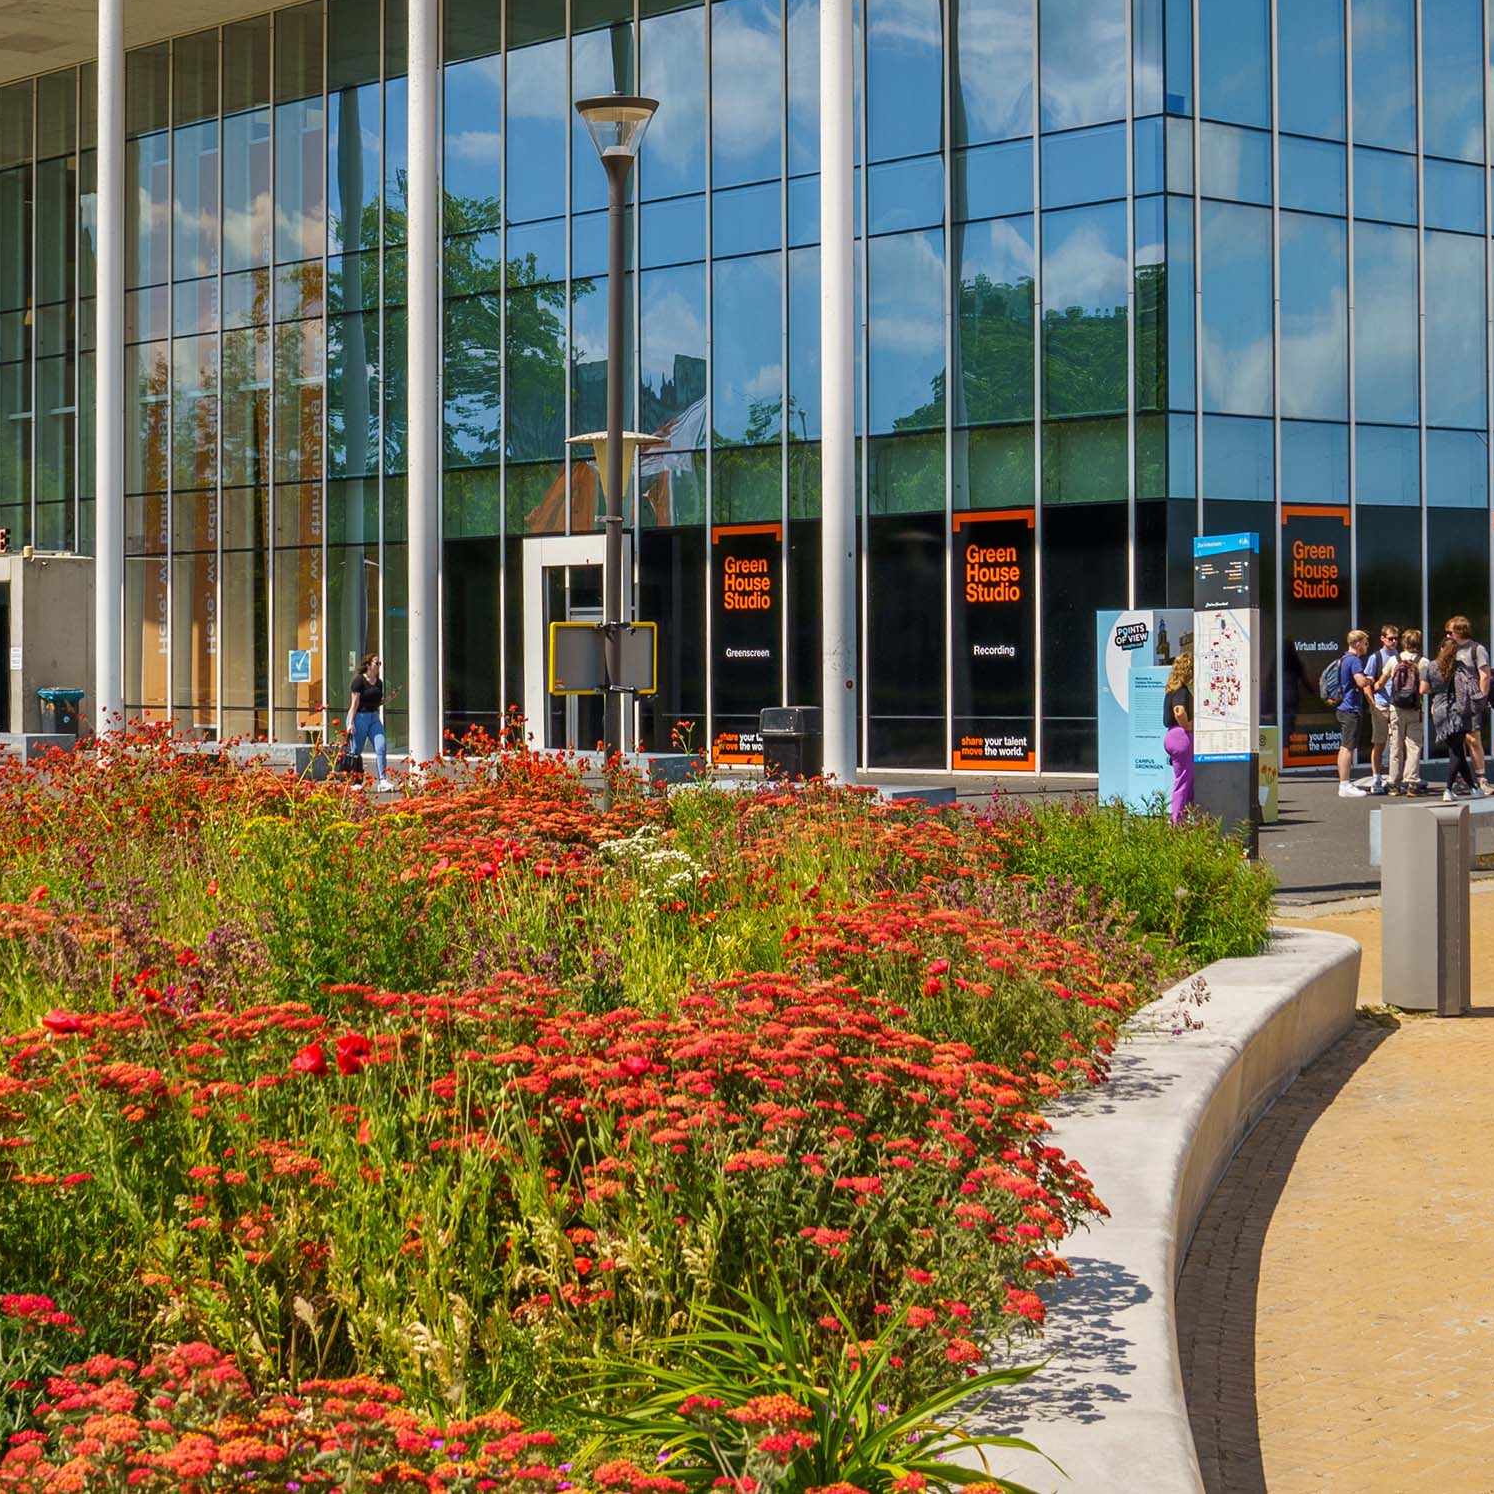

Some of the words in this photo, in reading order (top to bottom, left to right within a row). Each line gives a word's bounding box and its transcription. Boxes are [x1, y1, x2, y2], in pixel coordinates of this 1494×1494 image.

[966, 544, 1017, 563] Green
[1292, 540, 1336, 559] Green
[724, 556, 768, 574] Green
[1293, 560, 1339, 579] House
[966, 564, 1020, 582] House
[724, 574, 771, 591] House
[1292, 579, 1339, 598] Studio
[966, 583, 1020, 602] Studio
[724, 592, 771, 610] Studio
[1117, 624, 1145, 636] POINTS
[1115, 635, 1127, 645] OF
[1127, 632, 1148, 643] VIEW
[973, 645, 1016, 657] Recording
[1294, 641, 1317, 651] Virtual
[1317, 641, 1339, 651] studio
[725, 648, 770, 658] Greenscreen
[739, 733, 755, 742] your
[961, 736, 984, 746] share
[984, 737, 1003, 746] your
[1003, 736, 1027, 746] talent
[1309, 732, 1325, 742] your
[1325, 731, 1343, 741] talen
[739, 742, 751, 751] the
[961, 747, 984, 756] move
[984, 746, 998, 756] the
[998, 746, 1024, 756] world.
[1309, 741, 1321, 751] the
